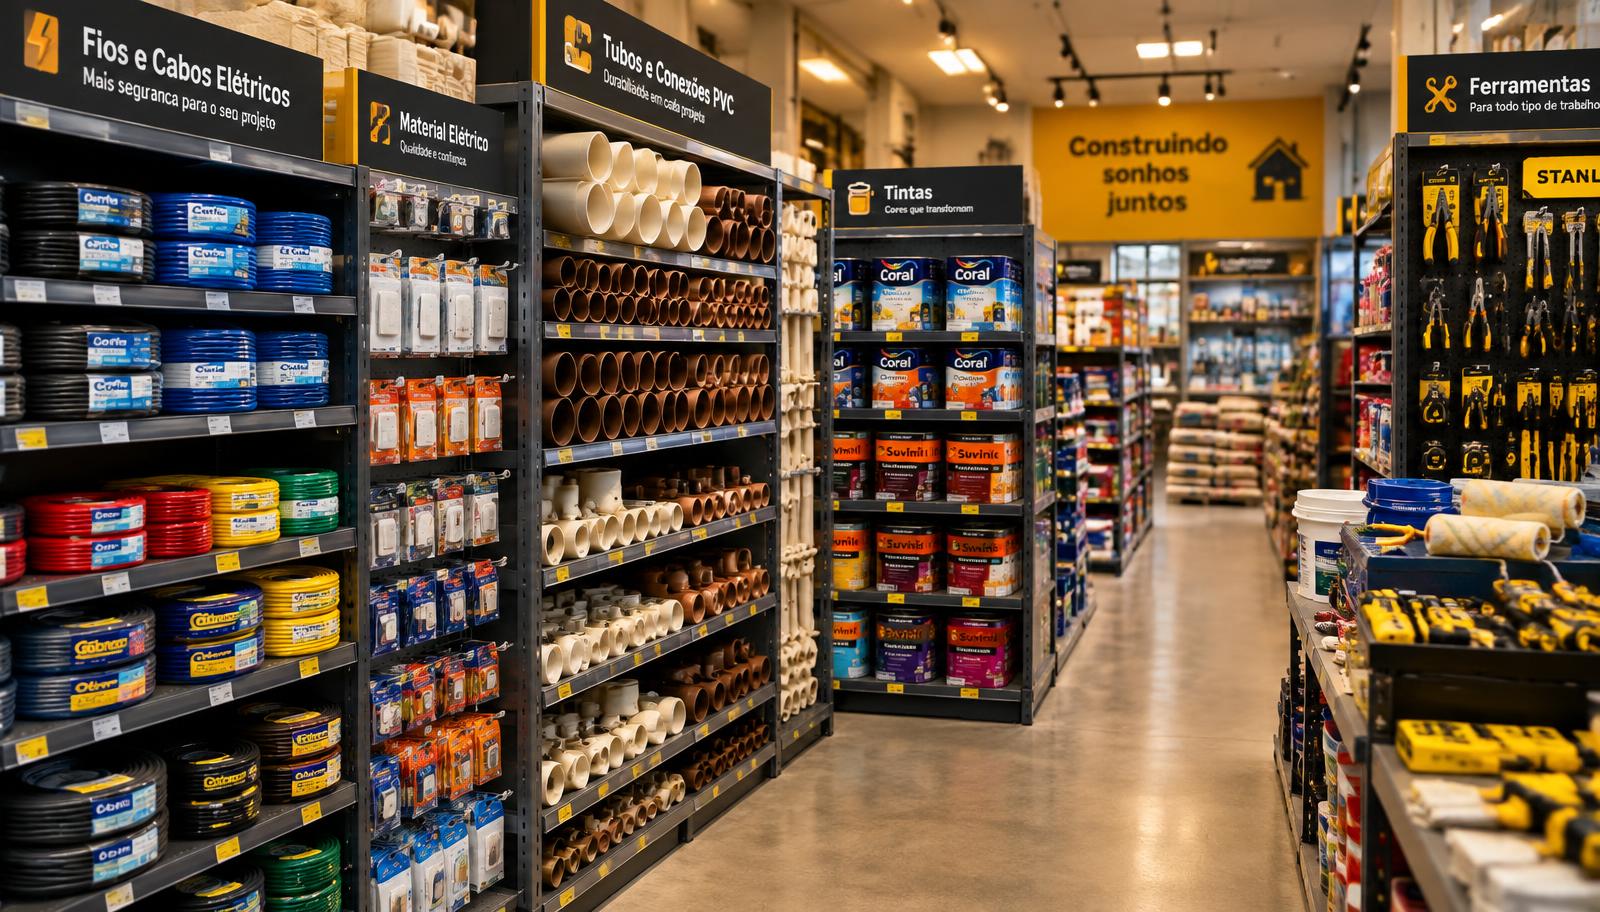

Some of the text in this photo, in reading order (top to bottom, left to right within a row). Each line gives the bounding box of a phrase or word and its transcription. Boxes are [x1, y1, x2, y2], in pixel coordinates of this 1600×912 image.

[83, 25, 291, 108] Fios e Cabos Elétricos
[602, 33, 735, 115] Tubos e Conexões PVC
[1470, 75, 1591, 95] Ferramentas
[83, 66, 115, 92] Mais
[182, 96, 207, 113] para
[210, 103, 217, 115] o
[241, 110, 276, 131] projeto
[1470, 102, 1493, 112] Para
[1495, 101, 1519, 112] todo
[1521, 101, 1542, 113] tipo
[1544, 99, 1557, 110] de
[400, 111, 489, 152] Material Elétrico
[1069, 131, 1228, 157] Construindo
[1103, 163, 1190, 184] sonhos
[884, 185, 933, 200] Tintas
[884, 205, 908, 214] Cores
[910, 206, 924, 215] que
[1106, 192, 1187, 217] juntos
[881, 268, 914, 281] Coral
[955, 267, 990, 280] Coral
[880, 356, 911, 368] Coral
[954, 356, 988, 368] Coral
